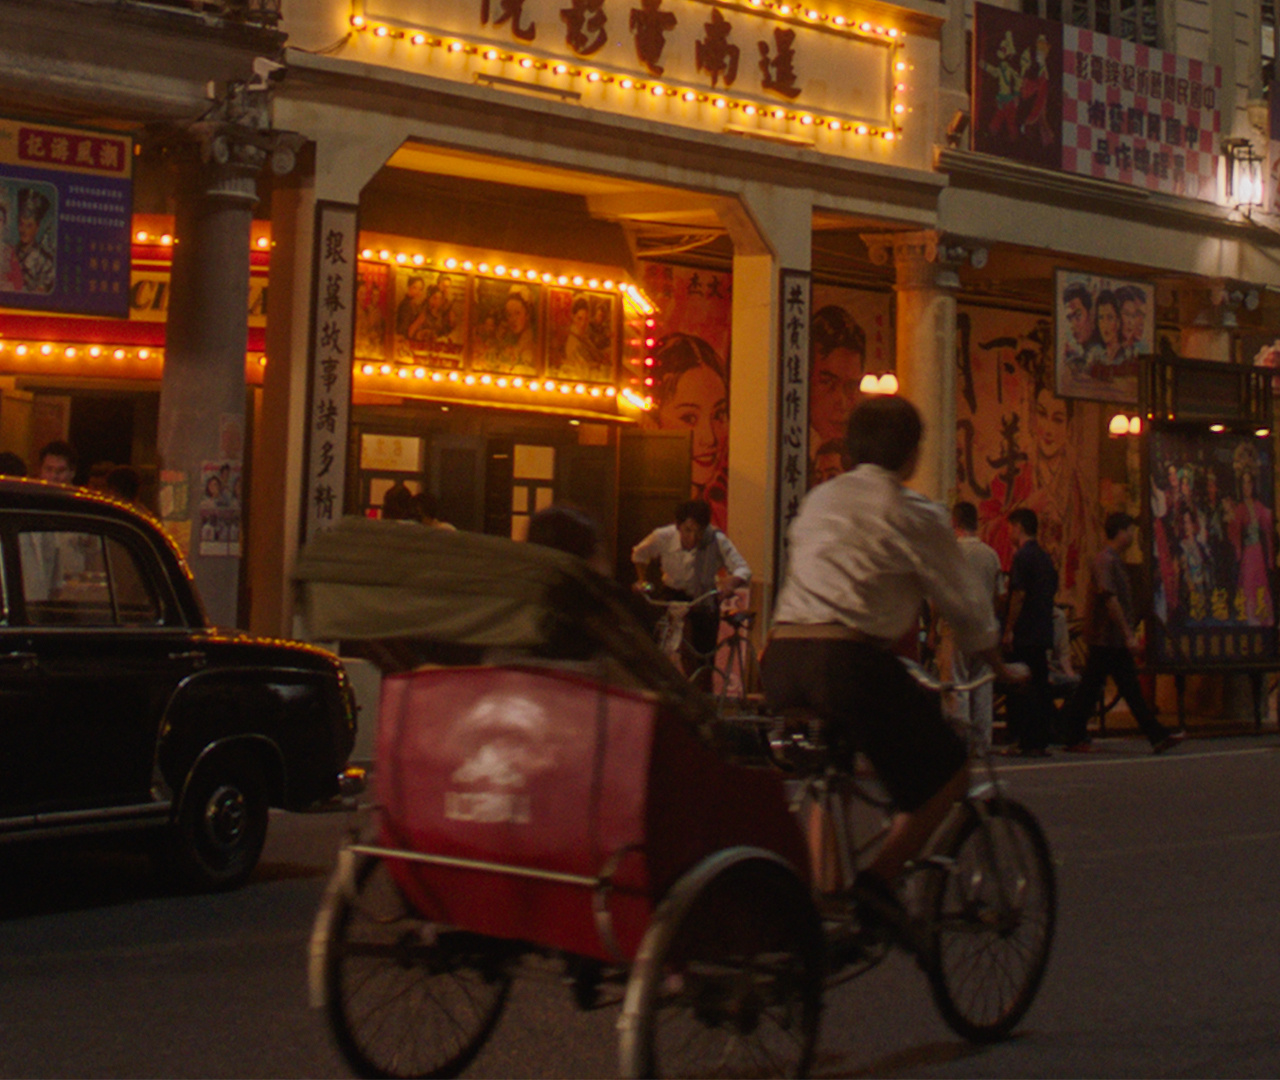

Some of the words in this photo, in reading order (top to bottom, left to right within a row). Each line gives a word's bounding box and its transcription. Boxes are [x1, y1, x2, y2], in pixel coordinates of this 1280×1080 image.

[313, 228, 347, 533] 銀幕故事諸多精
[783, 283, 806, 549] 共賞佳作心聲共
